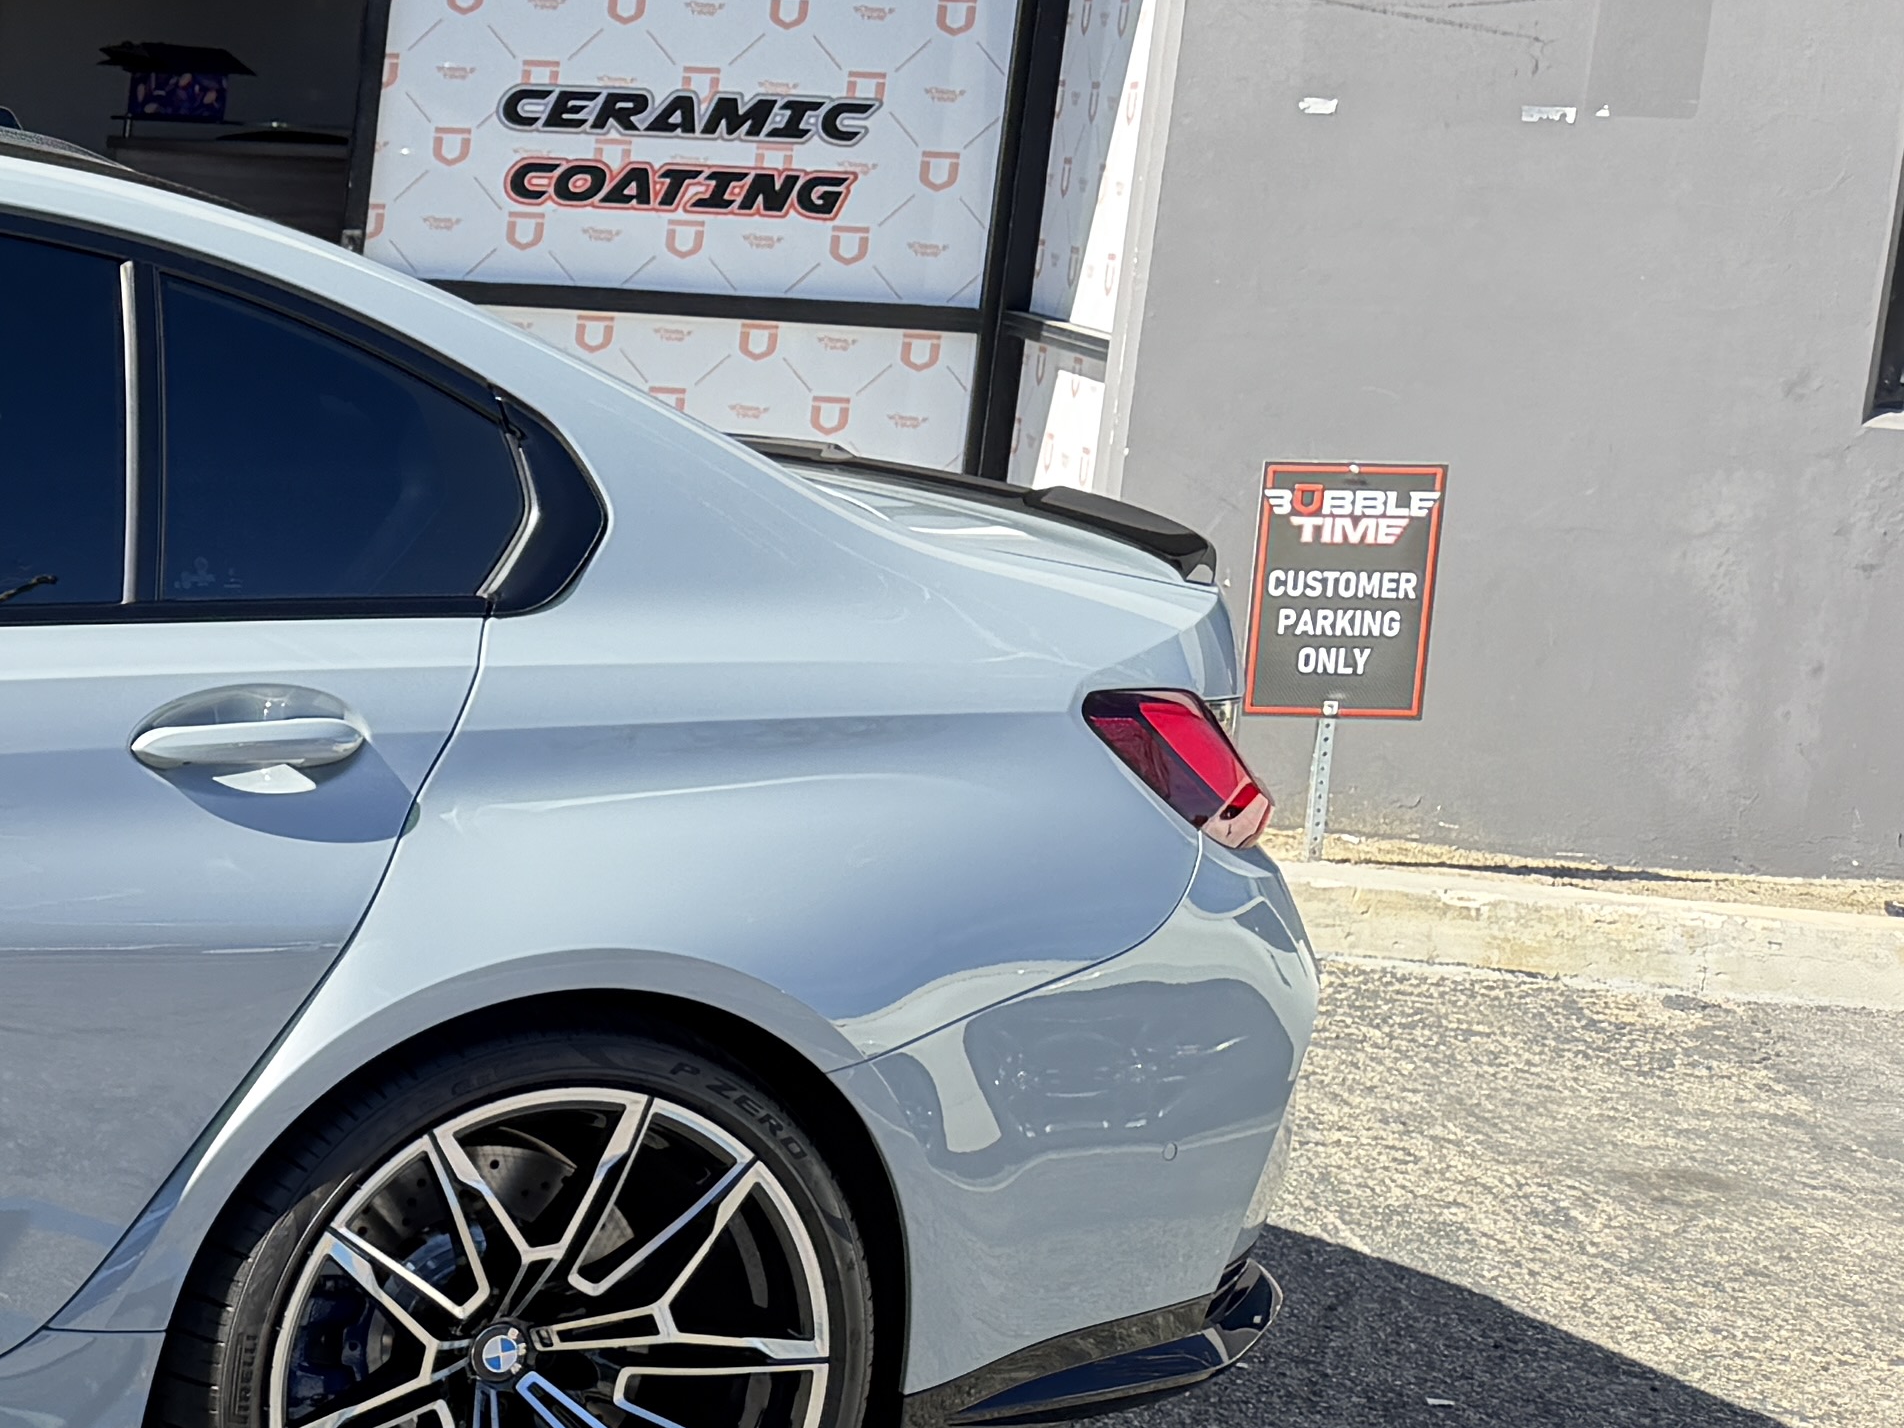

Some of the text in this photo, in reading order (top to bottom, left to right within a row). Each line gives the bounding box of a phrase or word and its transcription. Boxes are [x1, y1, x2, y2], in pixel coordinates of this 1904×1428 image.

[496, 84, 884, 147] CERAMIC
[504, 157, 859, 221] COATING
[1264, 483, 1442, 517] BUBBLE
[1289, 516, 1411, 545] TIME
[1267, 569, 1418, 600] CUSTOMER
[1276, 608, 1401, 638] PARKING
[1297, 646, 1372, 675] ONLY
[669, 1061, 808, 1161] P ZERO
